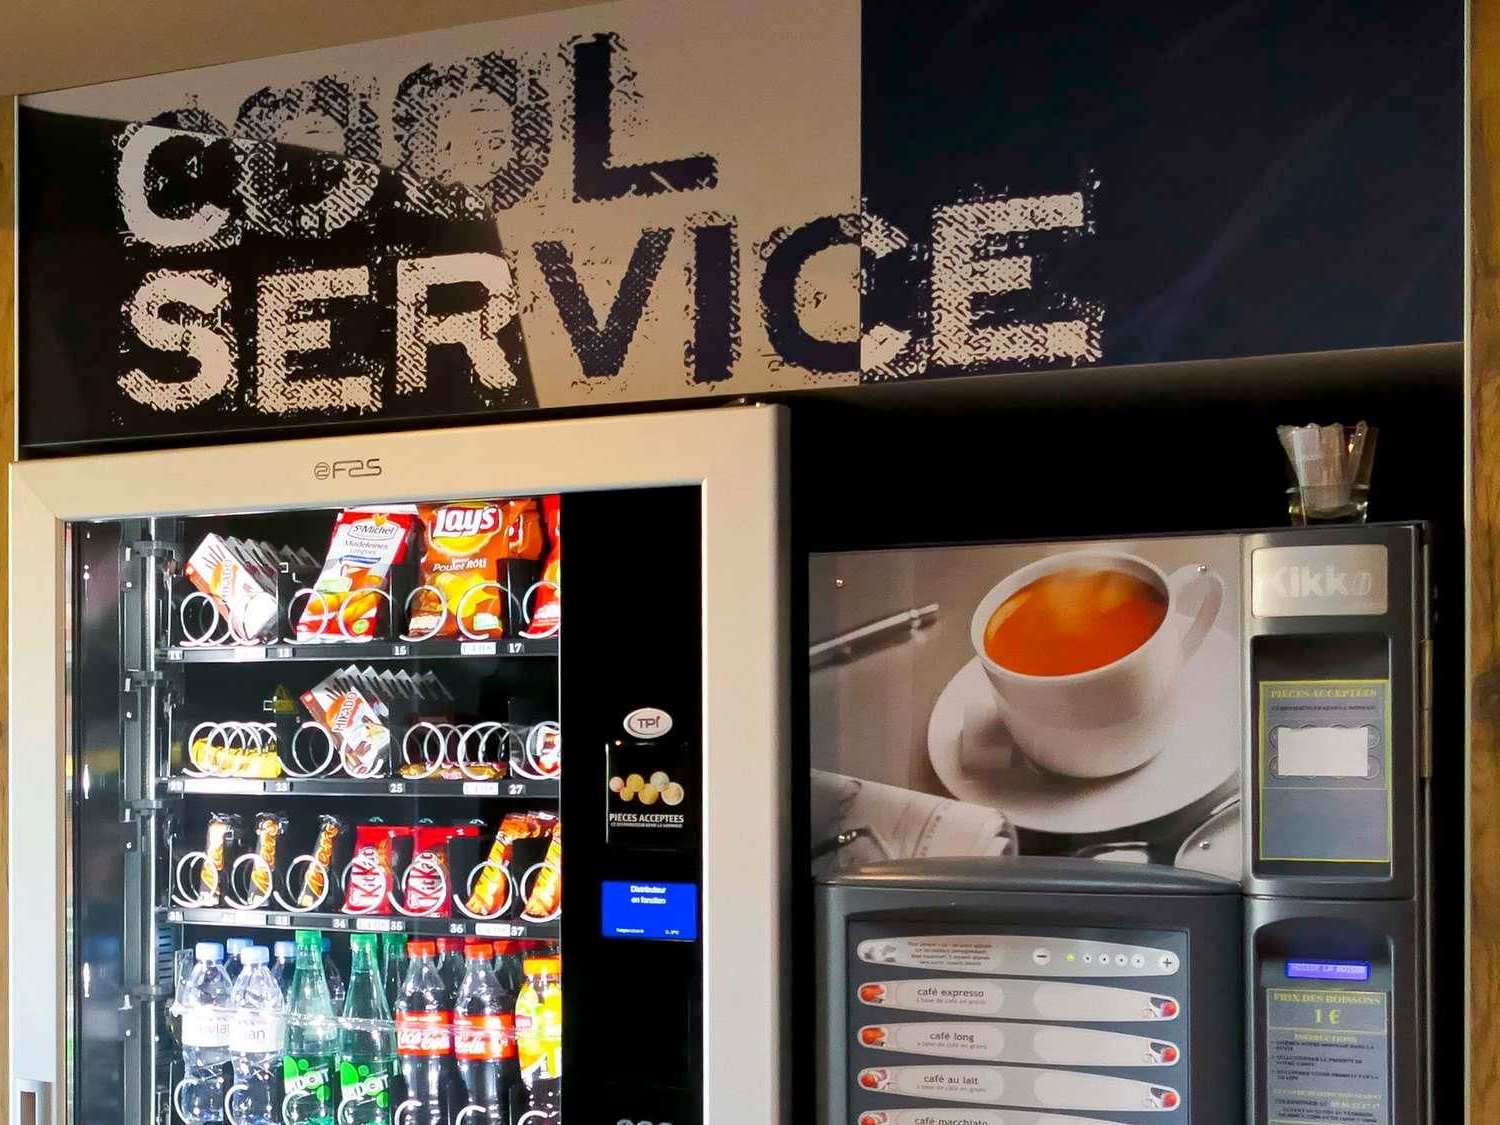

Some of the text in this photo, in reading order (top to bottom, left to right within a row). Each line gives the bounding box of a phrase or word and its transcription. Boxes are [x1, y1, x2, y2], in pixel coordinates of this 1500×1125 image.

[114, 32, 718, 250] COOL
[114, 182, 1105, 413] SERVICE
[508, 643, 523, 654] 17
[389, 783, 403, 793] 25
[509, 783, 523, 795] 27
[609, 813, 684, 823] PIECES ACCEPTEES
[450, 923, 464, 934] 36
[509, 926, 524, 937] 37
[916, 987, 984, 998] café expresso
[1315, 1009, 1340, 1025] 1 €
[930, 1032, 974, 1042] café long
[924, 1075, 945, 1083] café
[962, 1076, 979, 1085] lait
[914, 1117, 935, 1125] café
